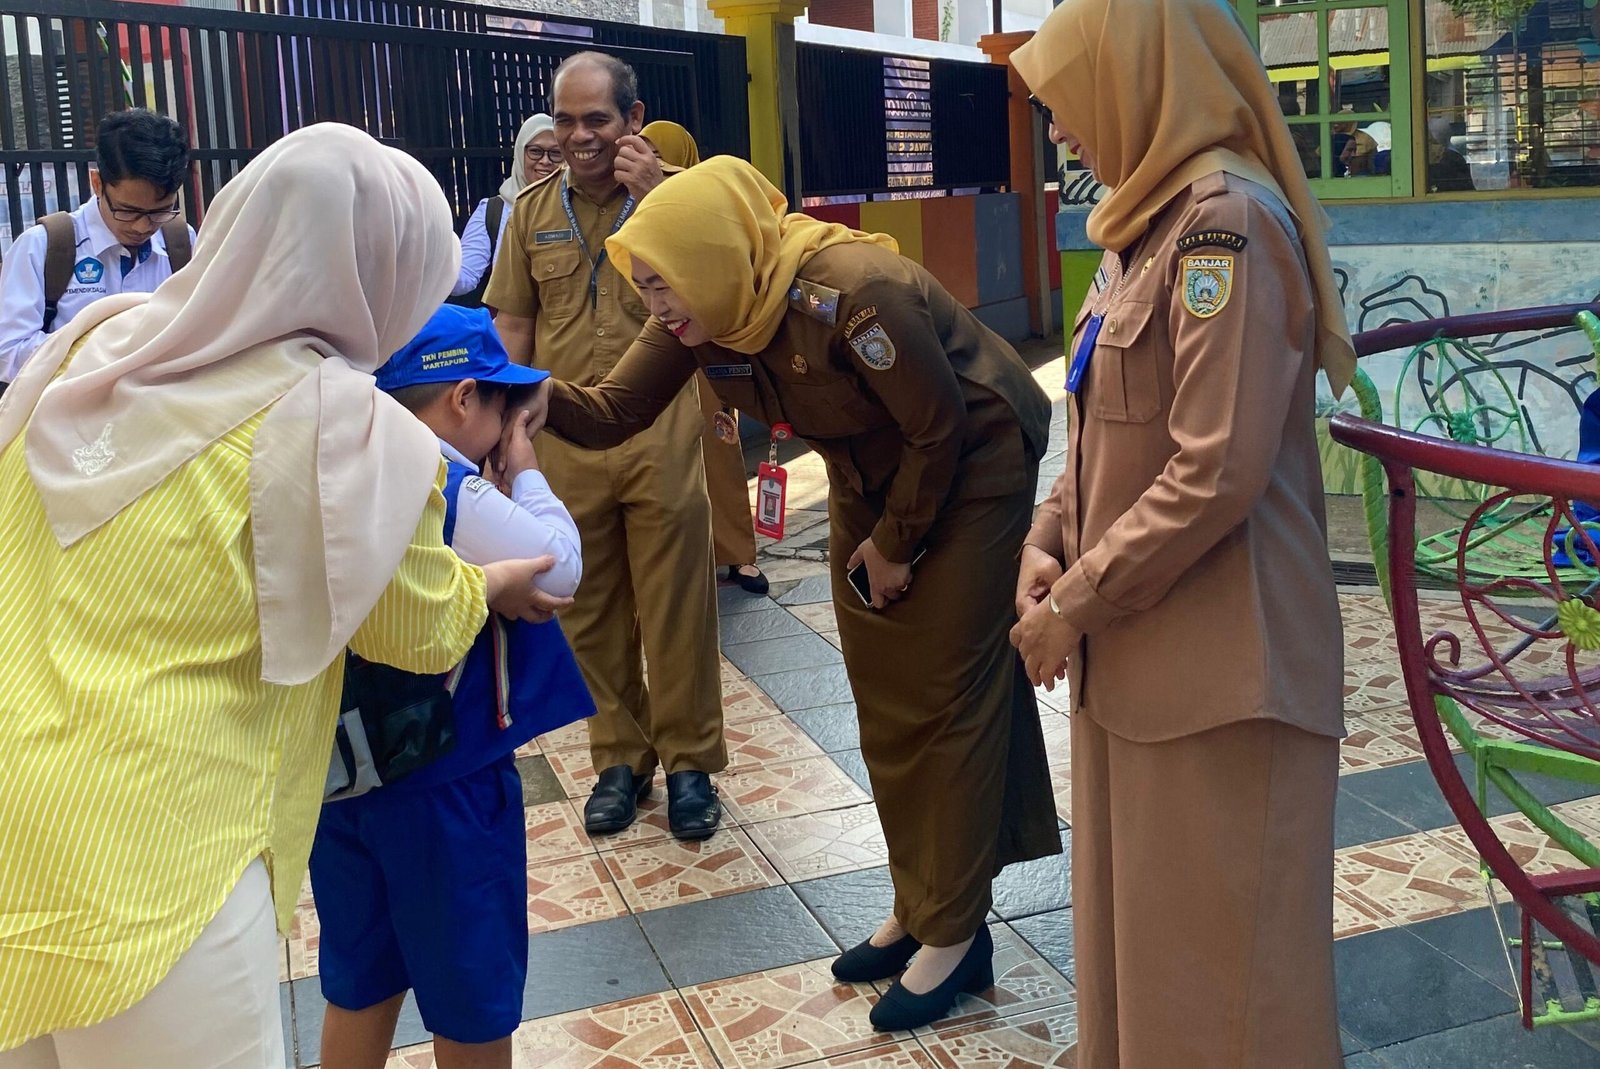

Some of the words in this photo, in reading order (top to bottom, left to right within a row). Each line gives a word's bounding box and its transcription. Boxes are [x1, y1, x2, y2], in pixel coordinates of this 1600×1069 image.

[615, 200, 633, 228] PEMKAB
[853, 327, 880, 346] BANJAR
[422, 354, 437, 362] TKN
[438, 348, 468, 359] PEMBINA
[423, 358, 469, 370] MARTAPURA
[728, 366, 750, 374] PENNY
